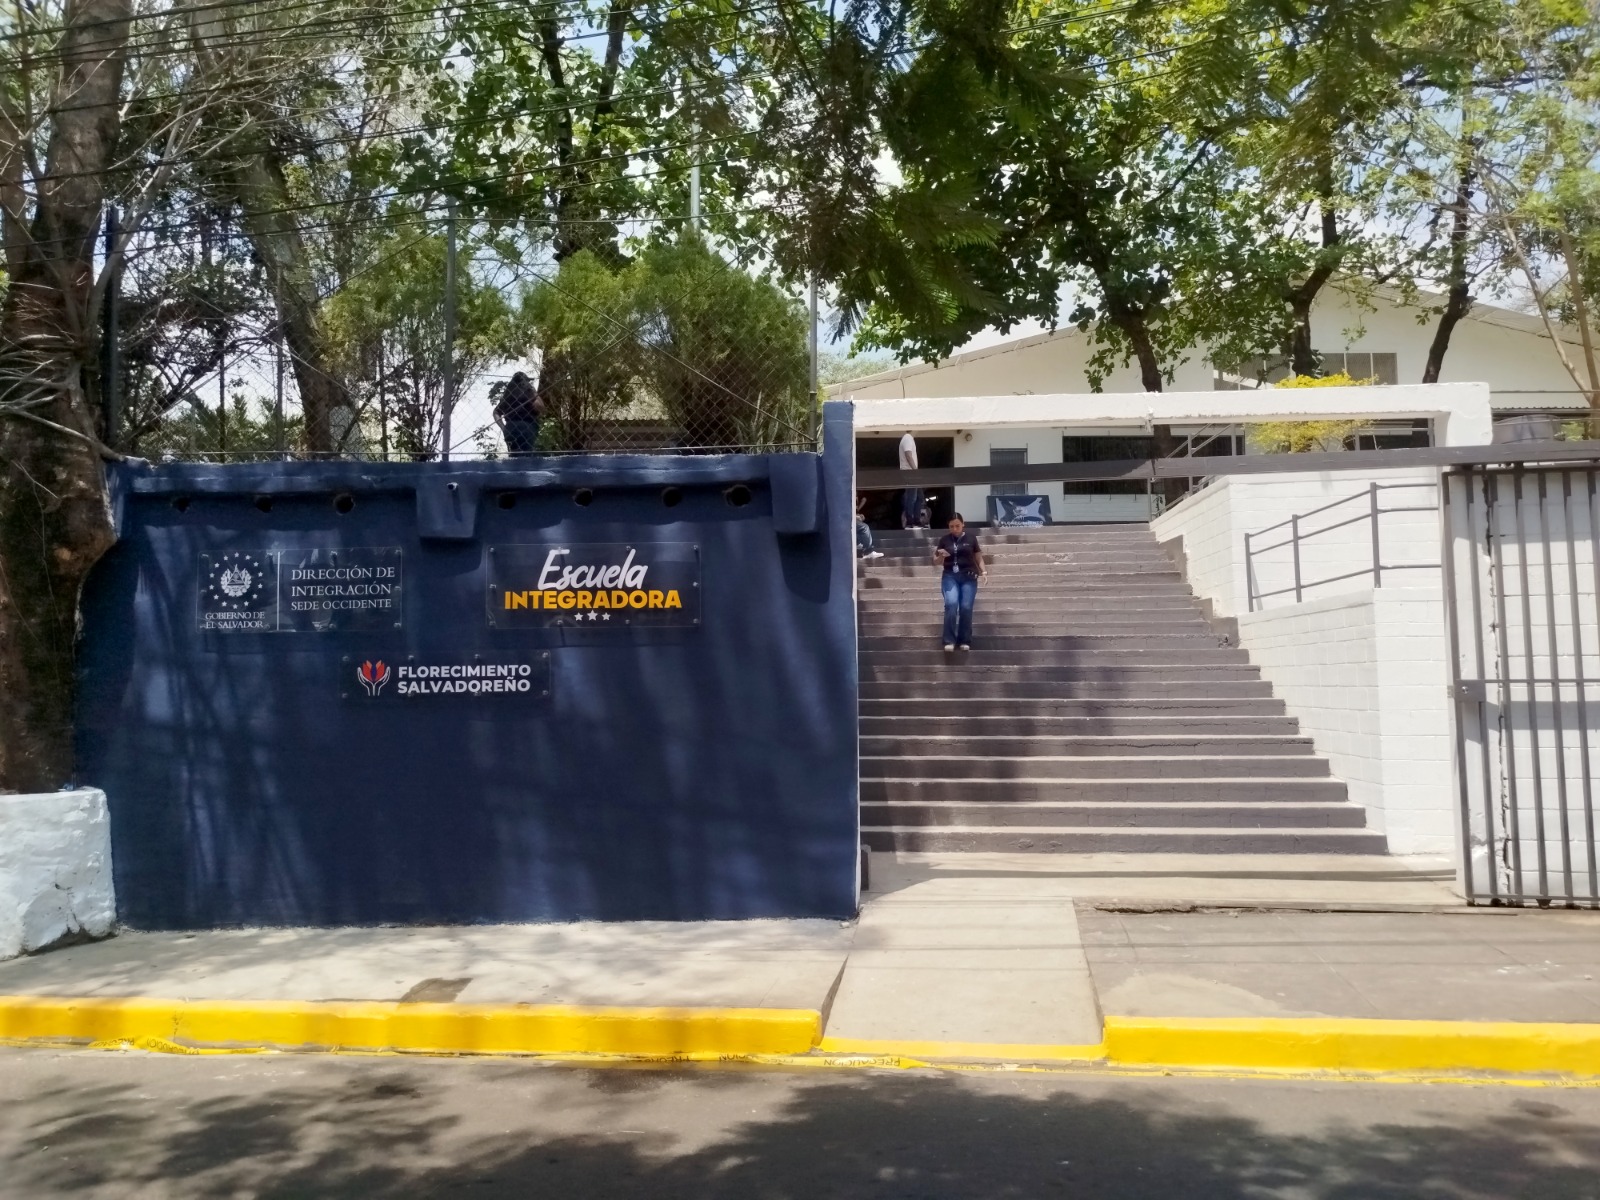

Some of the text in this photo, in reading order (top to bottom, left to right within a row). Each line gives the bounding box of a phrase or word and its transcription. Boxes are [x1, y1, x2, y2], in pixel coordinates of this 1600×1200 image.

[291, 565, 395, 580] DIRECCIÓN DE
[537, 548, 648, 591] Escuela
[291, 582, 392, 597] INTEGRACIÓN
[291, 599, 392, 611] SEDE OCCIDENTE
[504, 590, 683, 610] INTEGRADORA
[205, 611, 265, 621] GOBIERNO DE
[206, 620, 264, 630] EL SALVADOR
[398, 664, 531, 678] FLORECIMIENTO
[397, 676, 531, 693] SALVADOREÑO
